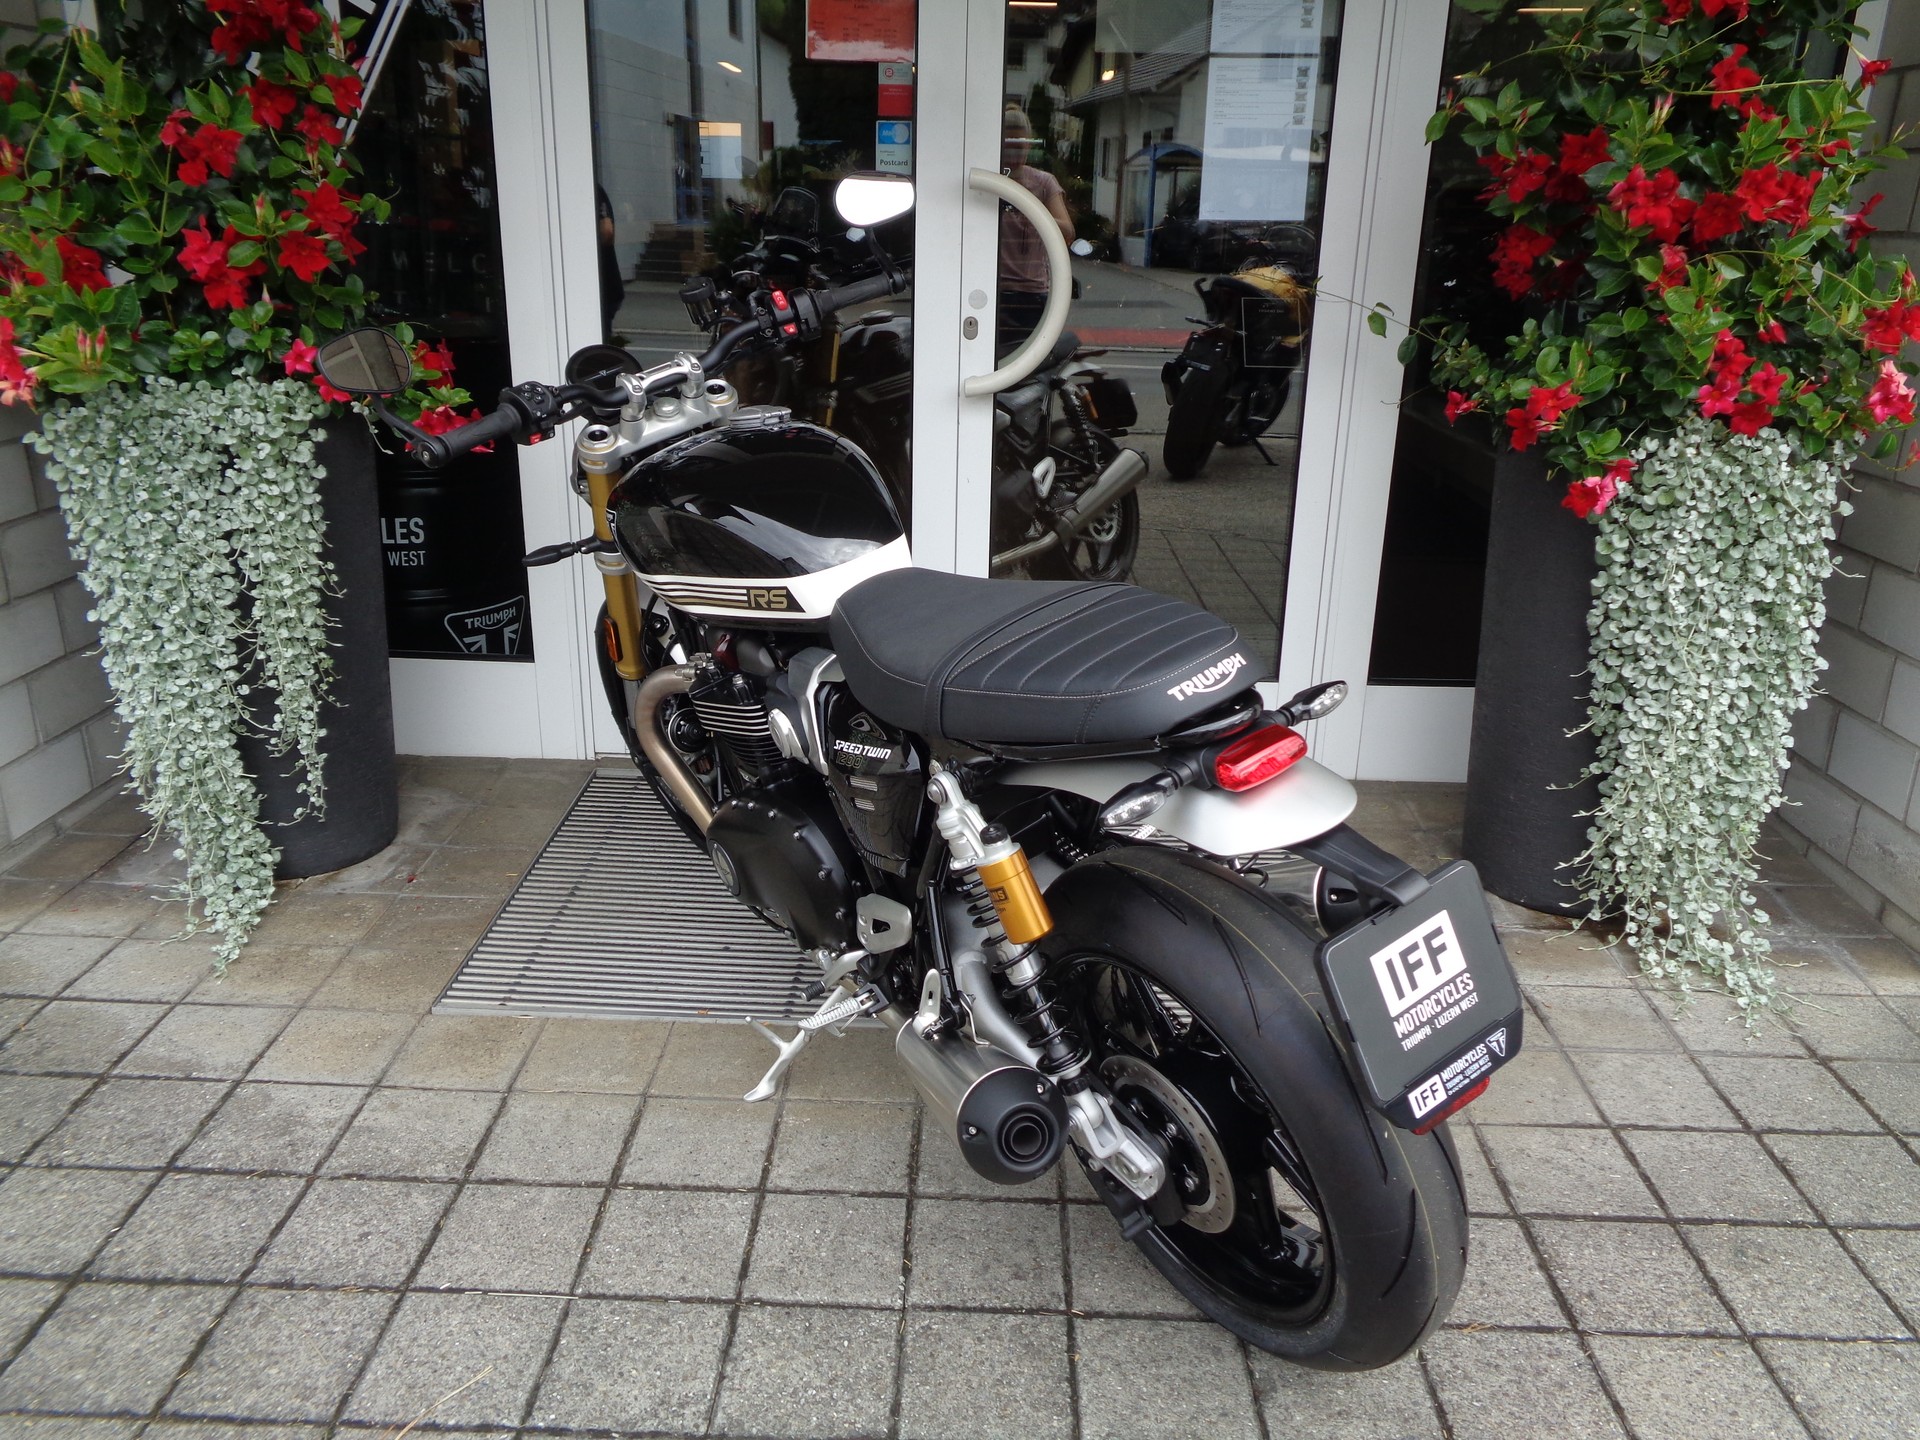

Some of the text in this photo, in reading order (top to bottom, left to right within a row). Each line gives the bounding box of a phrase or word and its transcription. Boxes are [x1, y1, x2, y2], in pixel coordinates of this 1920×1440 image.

[880, 159, 908, 167] Postcard
[388, 551, 425, 566] WEST
[750, 589, 788, 609] RS
[465, 606, 516, 630] TRIUMPH
[1166, 652, 1247, 702] TRIUMPH
[833, 740, 892, 760] SPEED TWIN
[1384, 925, 1448, 1001] IFF
[1393, 972, 1474, 1039] MOTORCYCLES
[1400, 1024, 1432, 1052] TRIUMPH
[1434, 1004, 1462, 1029] LUZERN
[1458, 992, 1479, 1012] WEST
[1414, 1081, 1439, 1112] IFF
[1440, 1043, 1487, 1082] MOTORCYCLES
